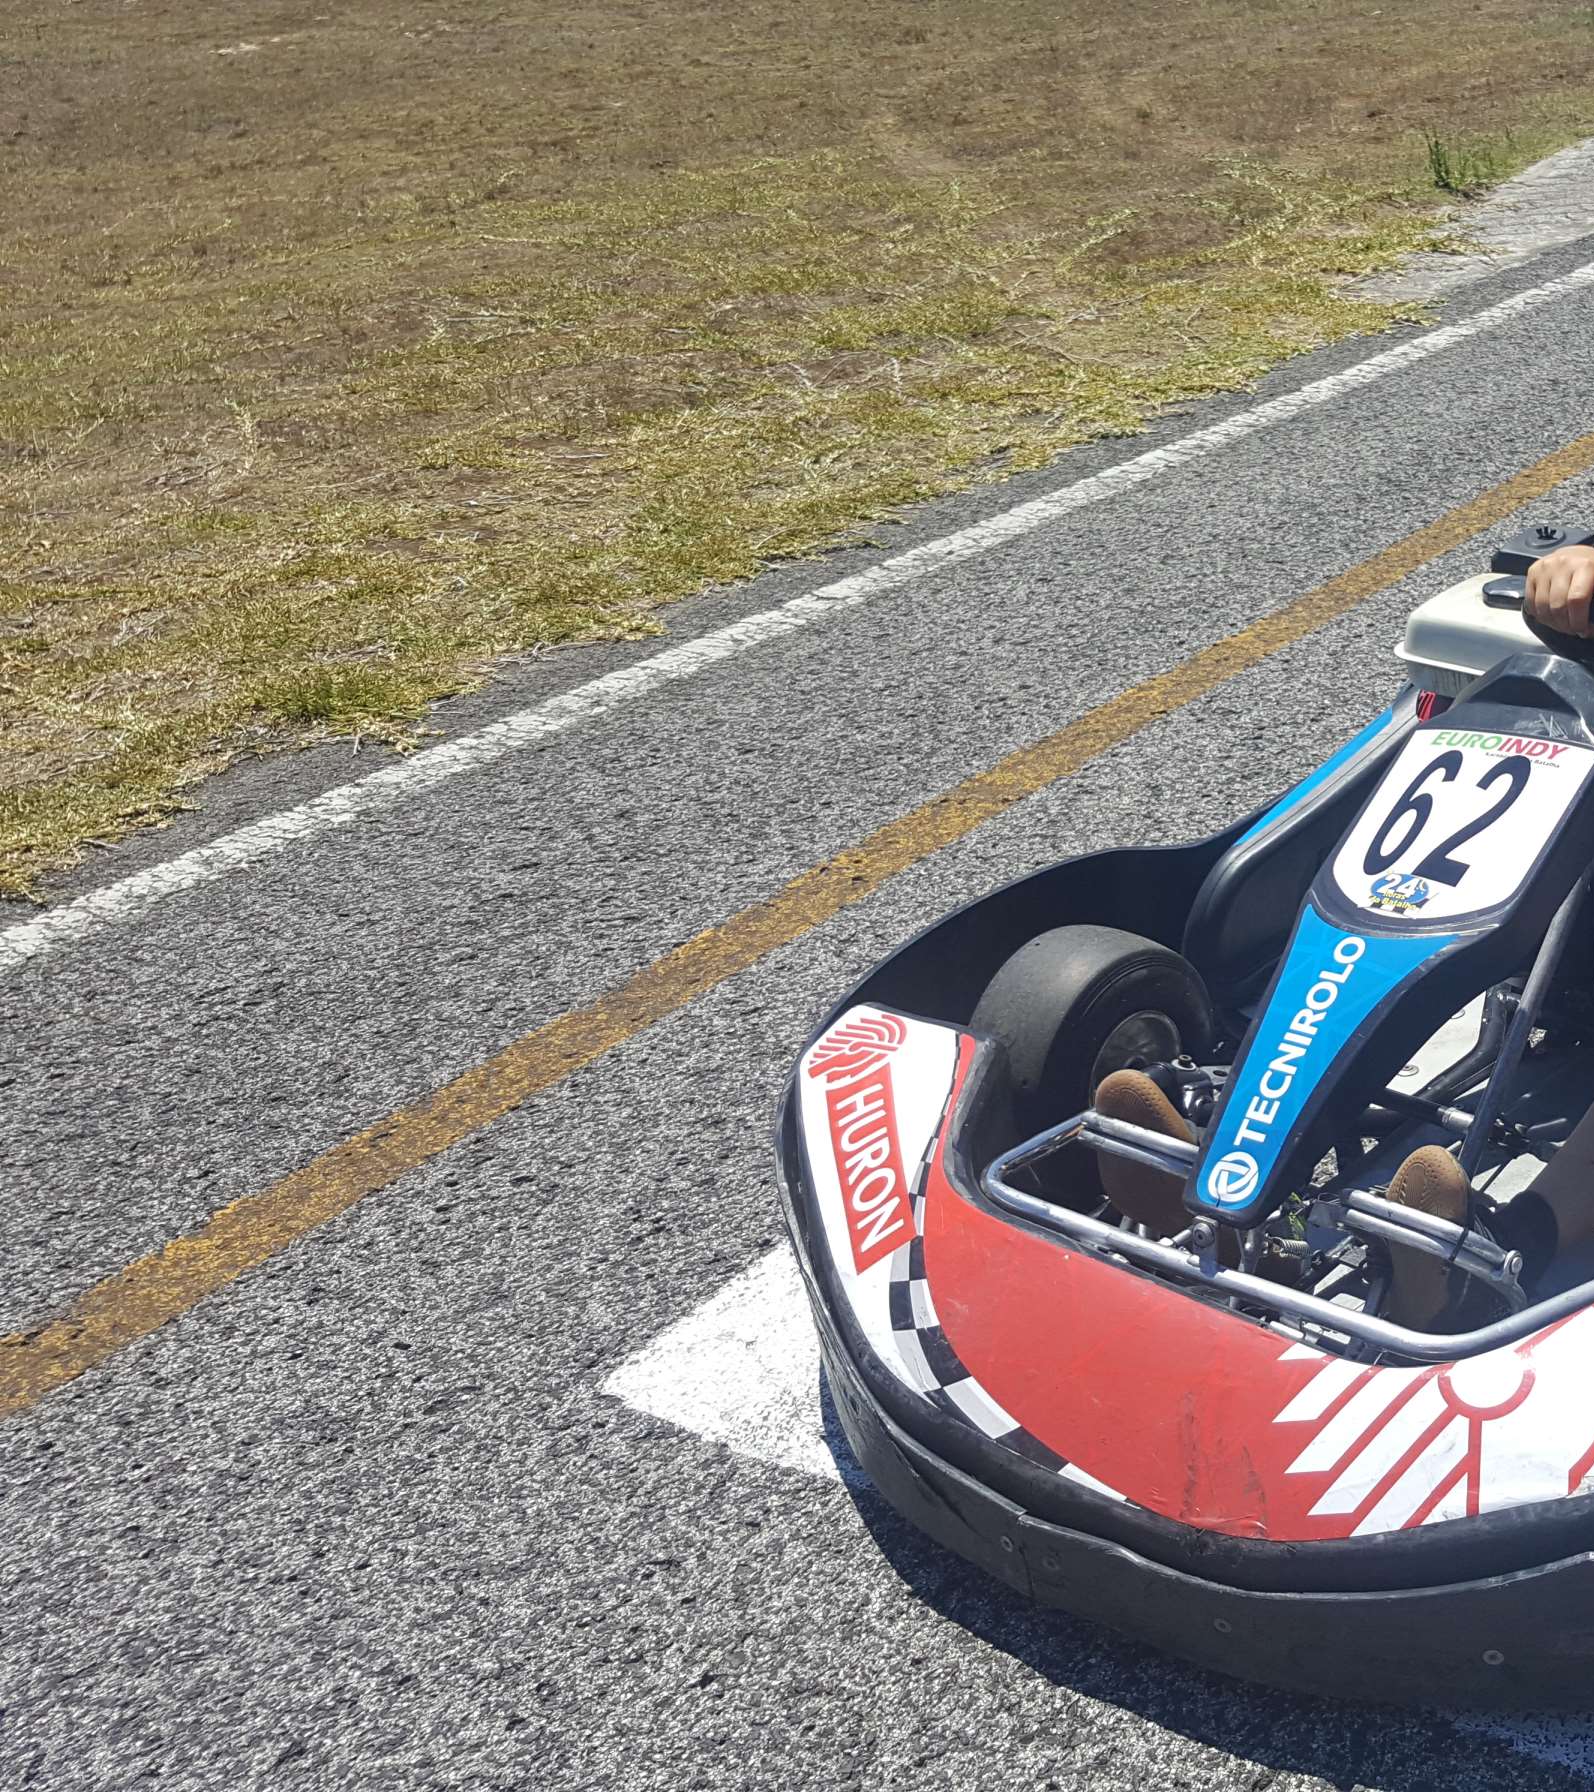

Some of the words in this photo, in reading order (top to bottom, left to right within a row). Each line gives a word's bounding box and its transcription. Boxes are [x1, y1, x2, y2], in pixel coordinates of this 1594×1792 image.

[1430, 731, 1569, 760] EUROINDY
[1363, 749, 1532, 888] 62
[1376, 873, 1421, 897] 24
[1234, 936, 1367, 1147] TECNIROLO
[835, 1083, 908, 1254] HURON
